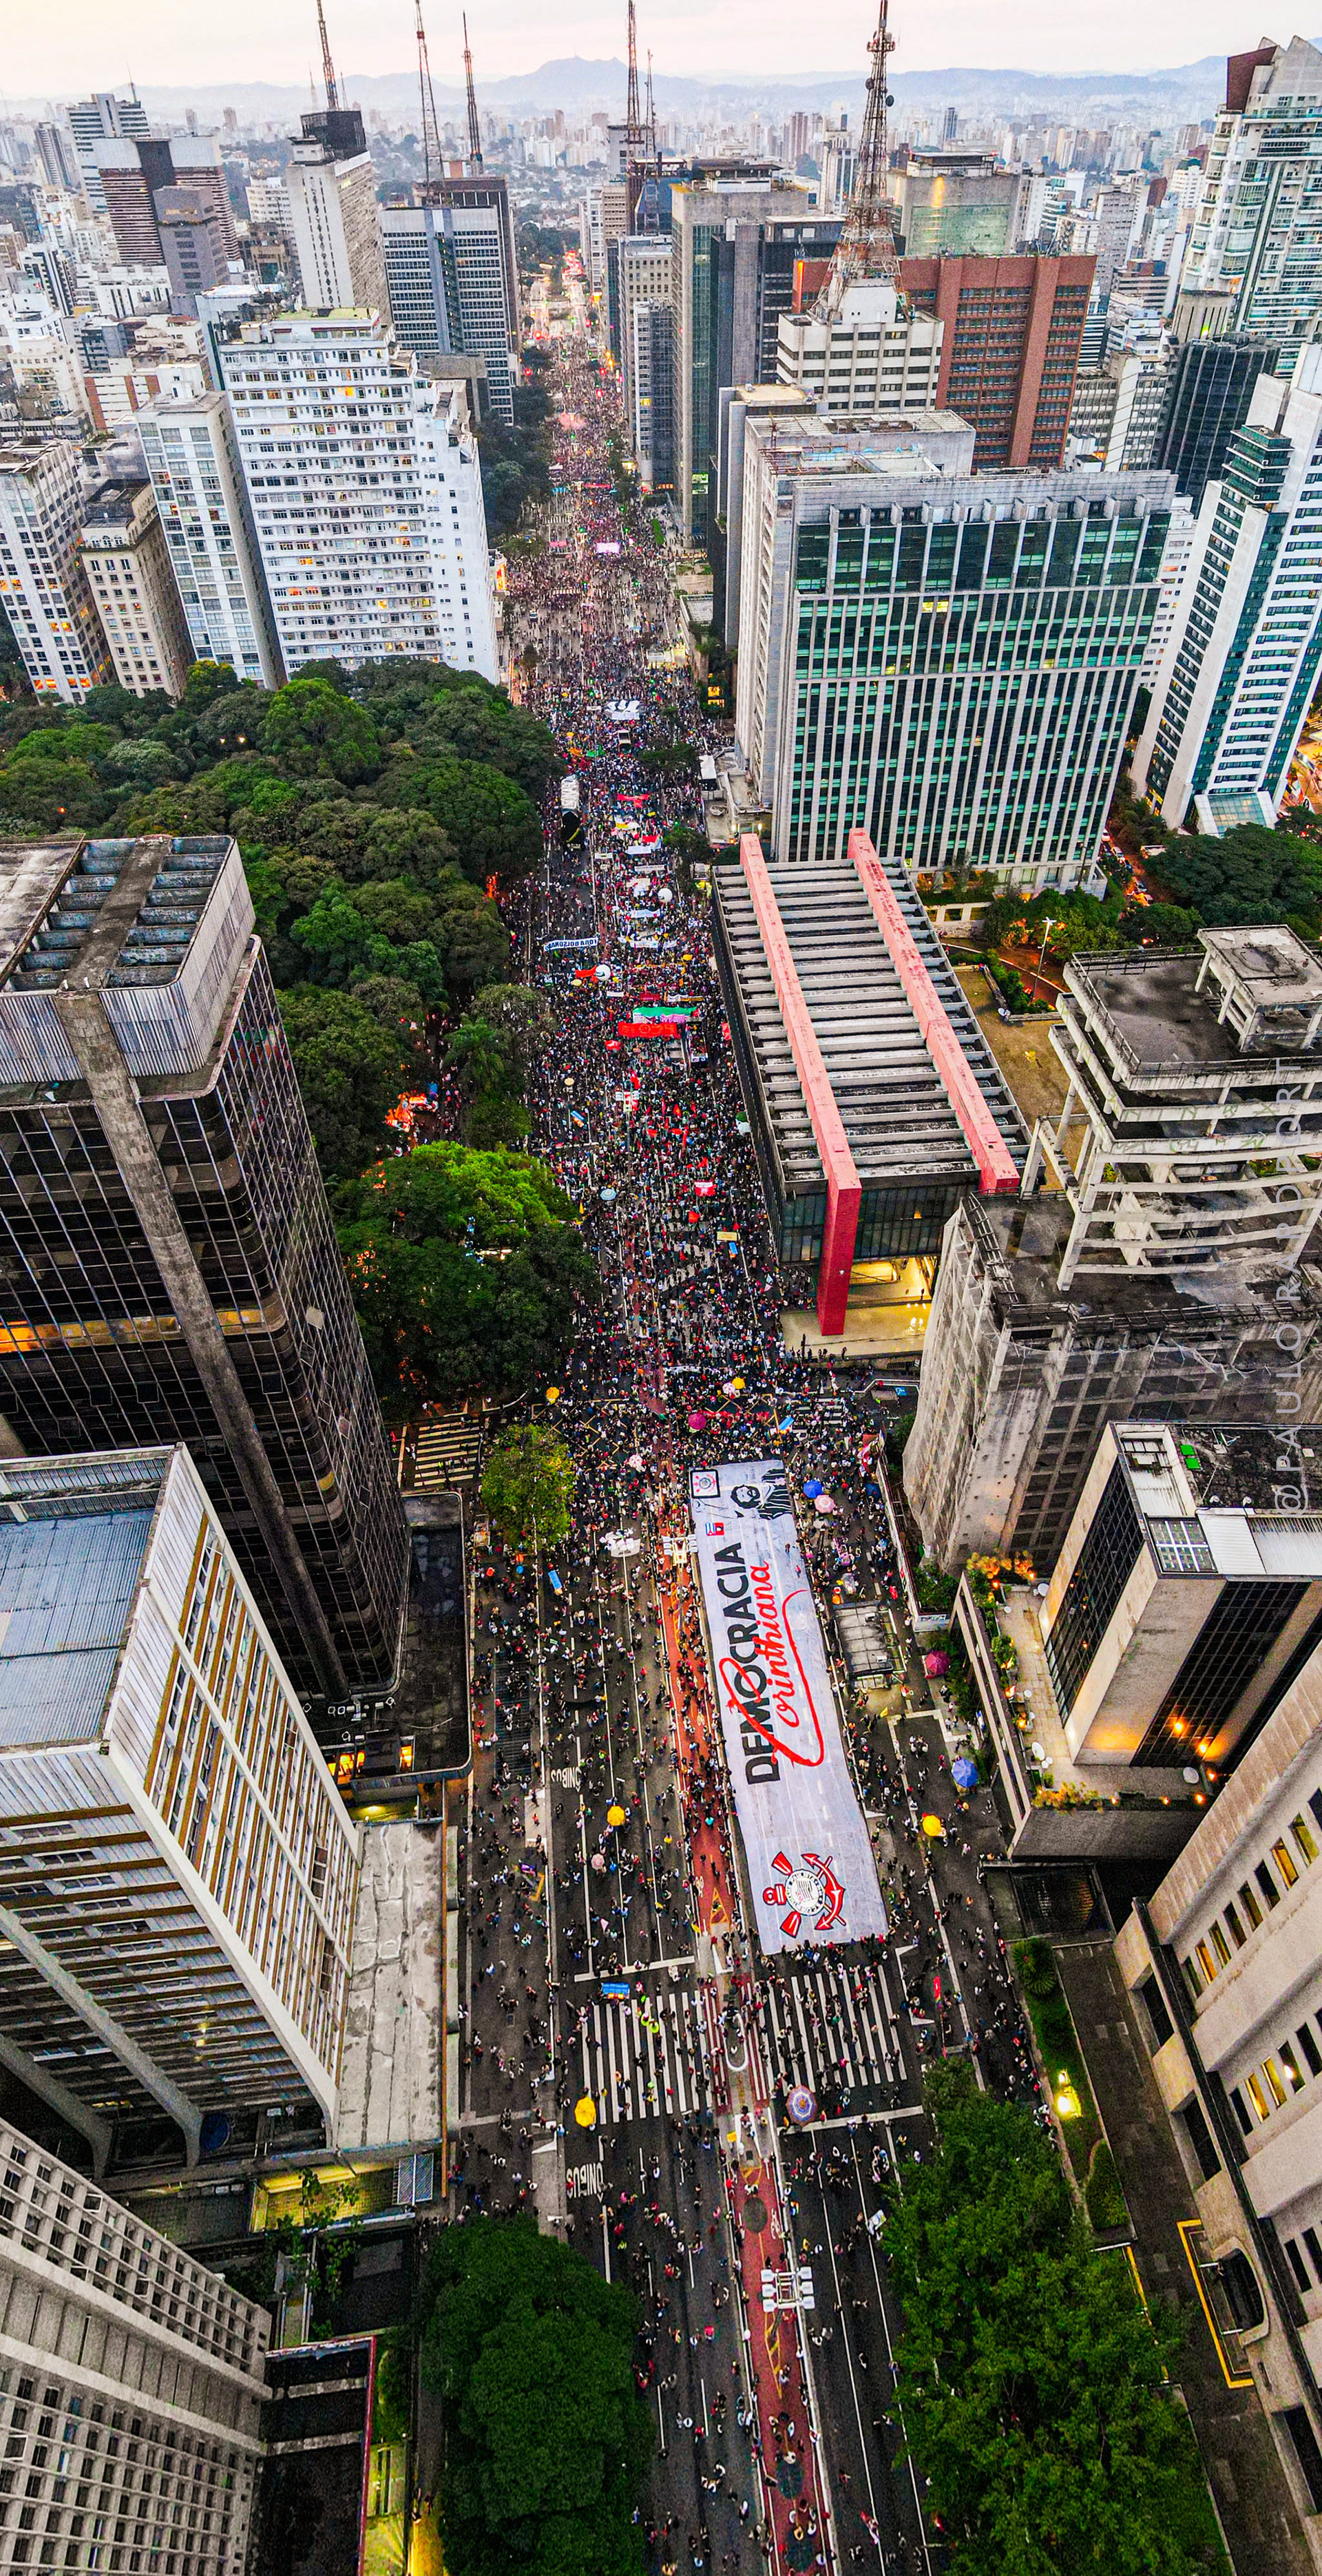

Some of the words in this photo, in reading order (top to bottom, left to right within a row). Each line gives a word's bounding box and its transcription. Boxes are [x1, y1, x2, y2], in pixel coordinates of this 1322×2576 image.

[714, 1542, 780, 1785] DEMOCRACIA
[551, 1766, 582, 1792] ÔNIBUS
[566, 2161, 604, 2203] ÔNIBUS
